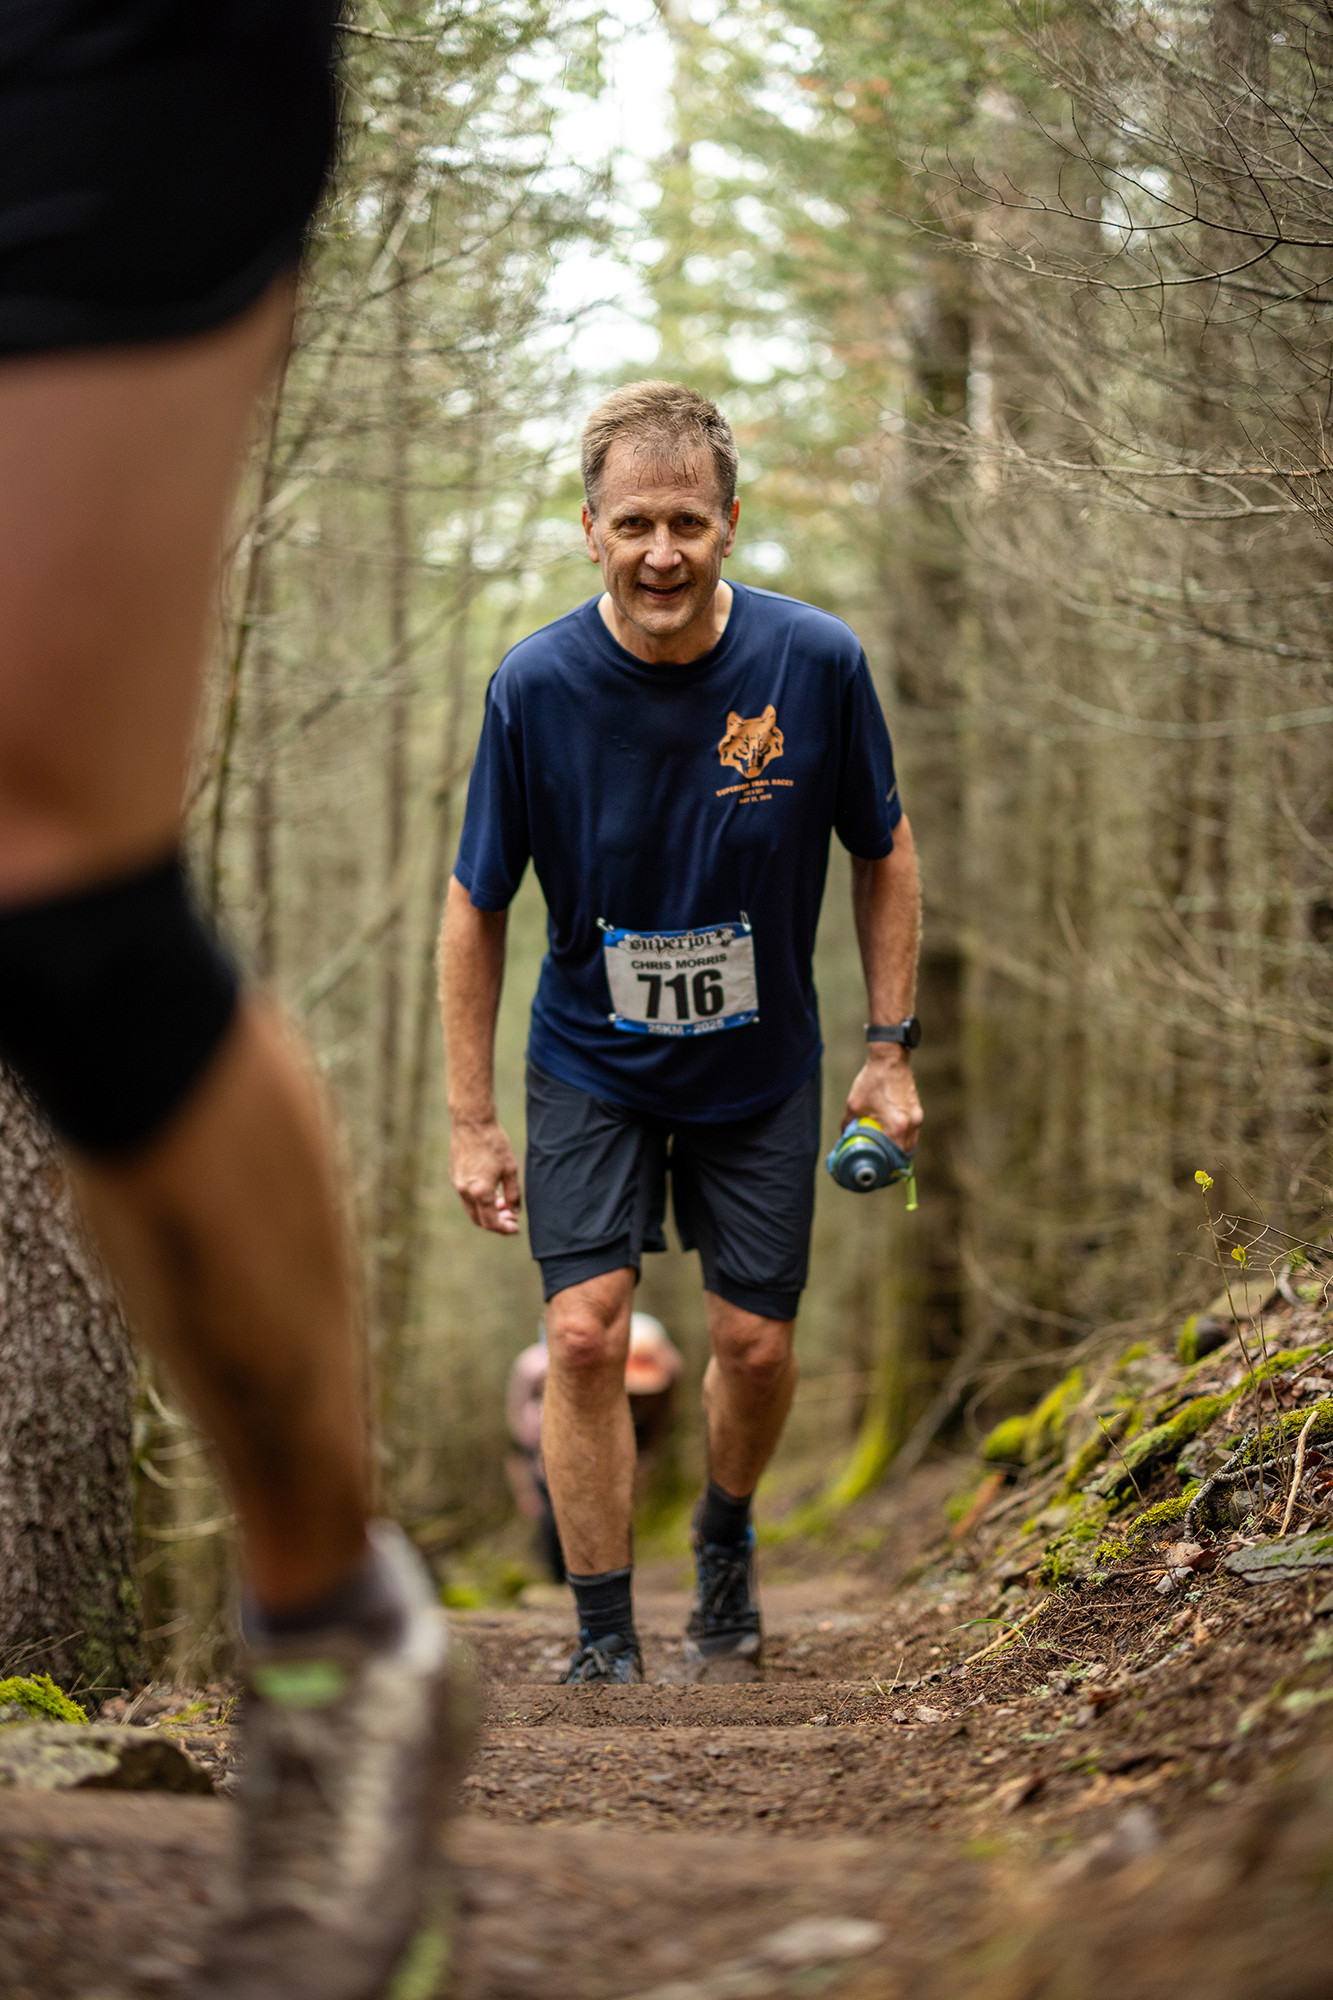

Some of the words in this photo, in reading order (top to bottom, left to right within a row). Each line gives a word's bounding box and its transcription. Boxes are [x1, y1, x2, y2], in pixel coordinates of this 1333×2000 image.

[631, 960, 672, 970] CHRIS
[675, 953, 728, 969] MORRIS
[637, 968, 724, 1021] 716
[647, 1023, 685, 1035] 25KM
[694, 1018, 725, 1034] 2025
